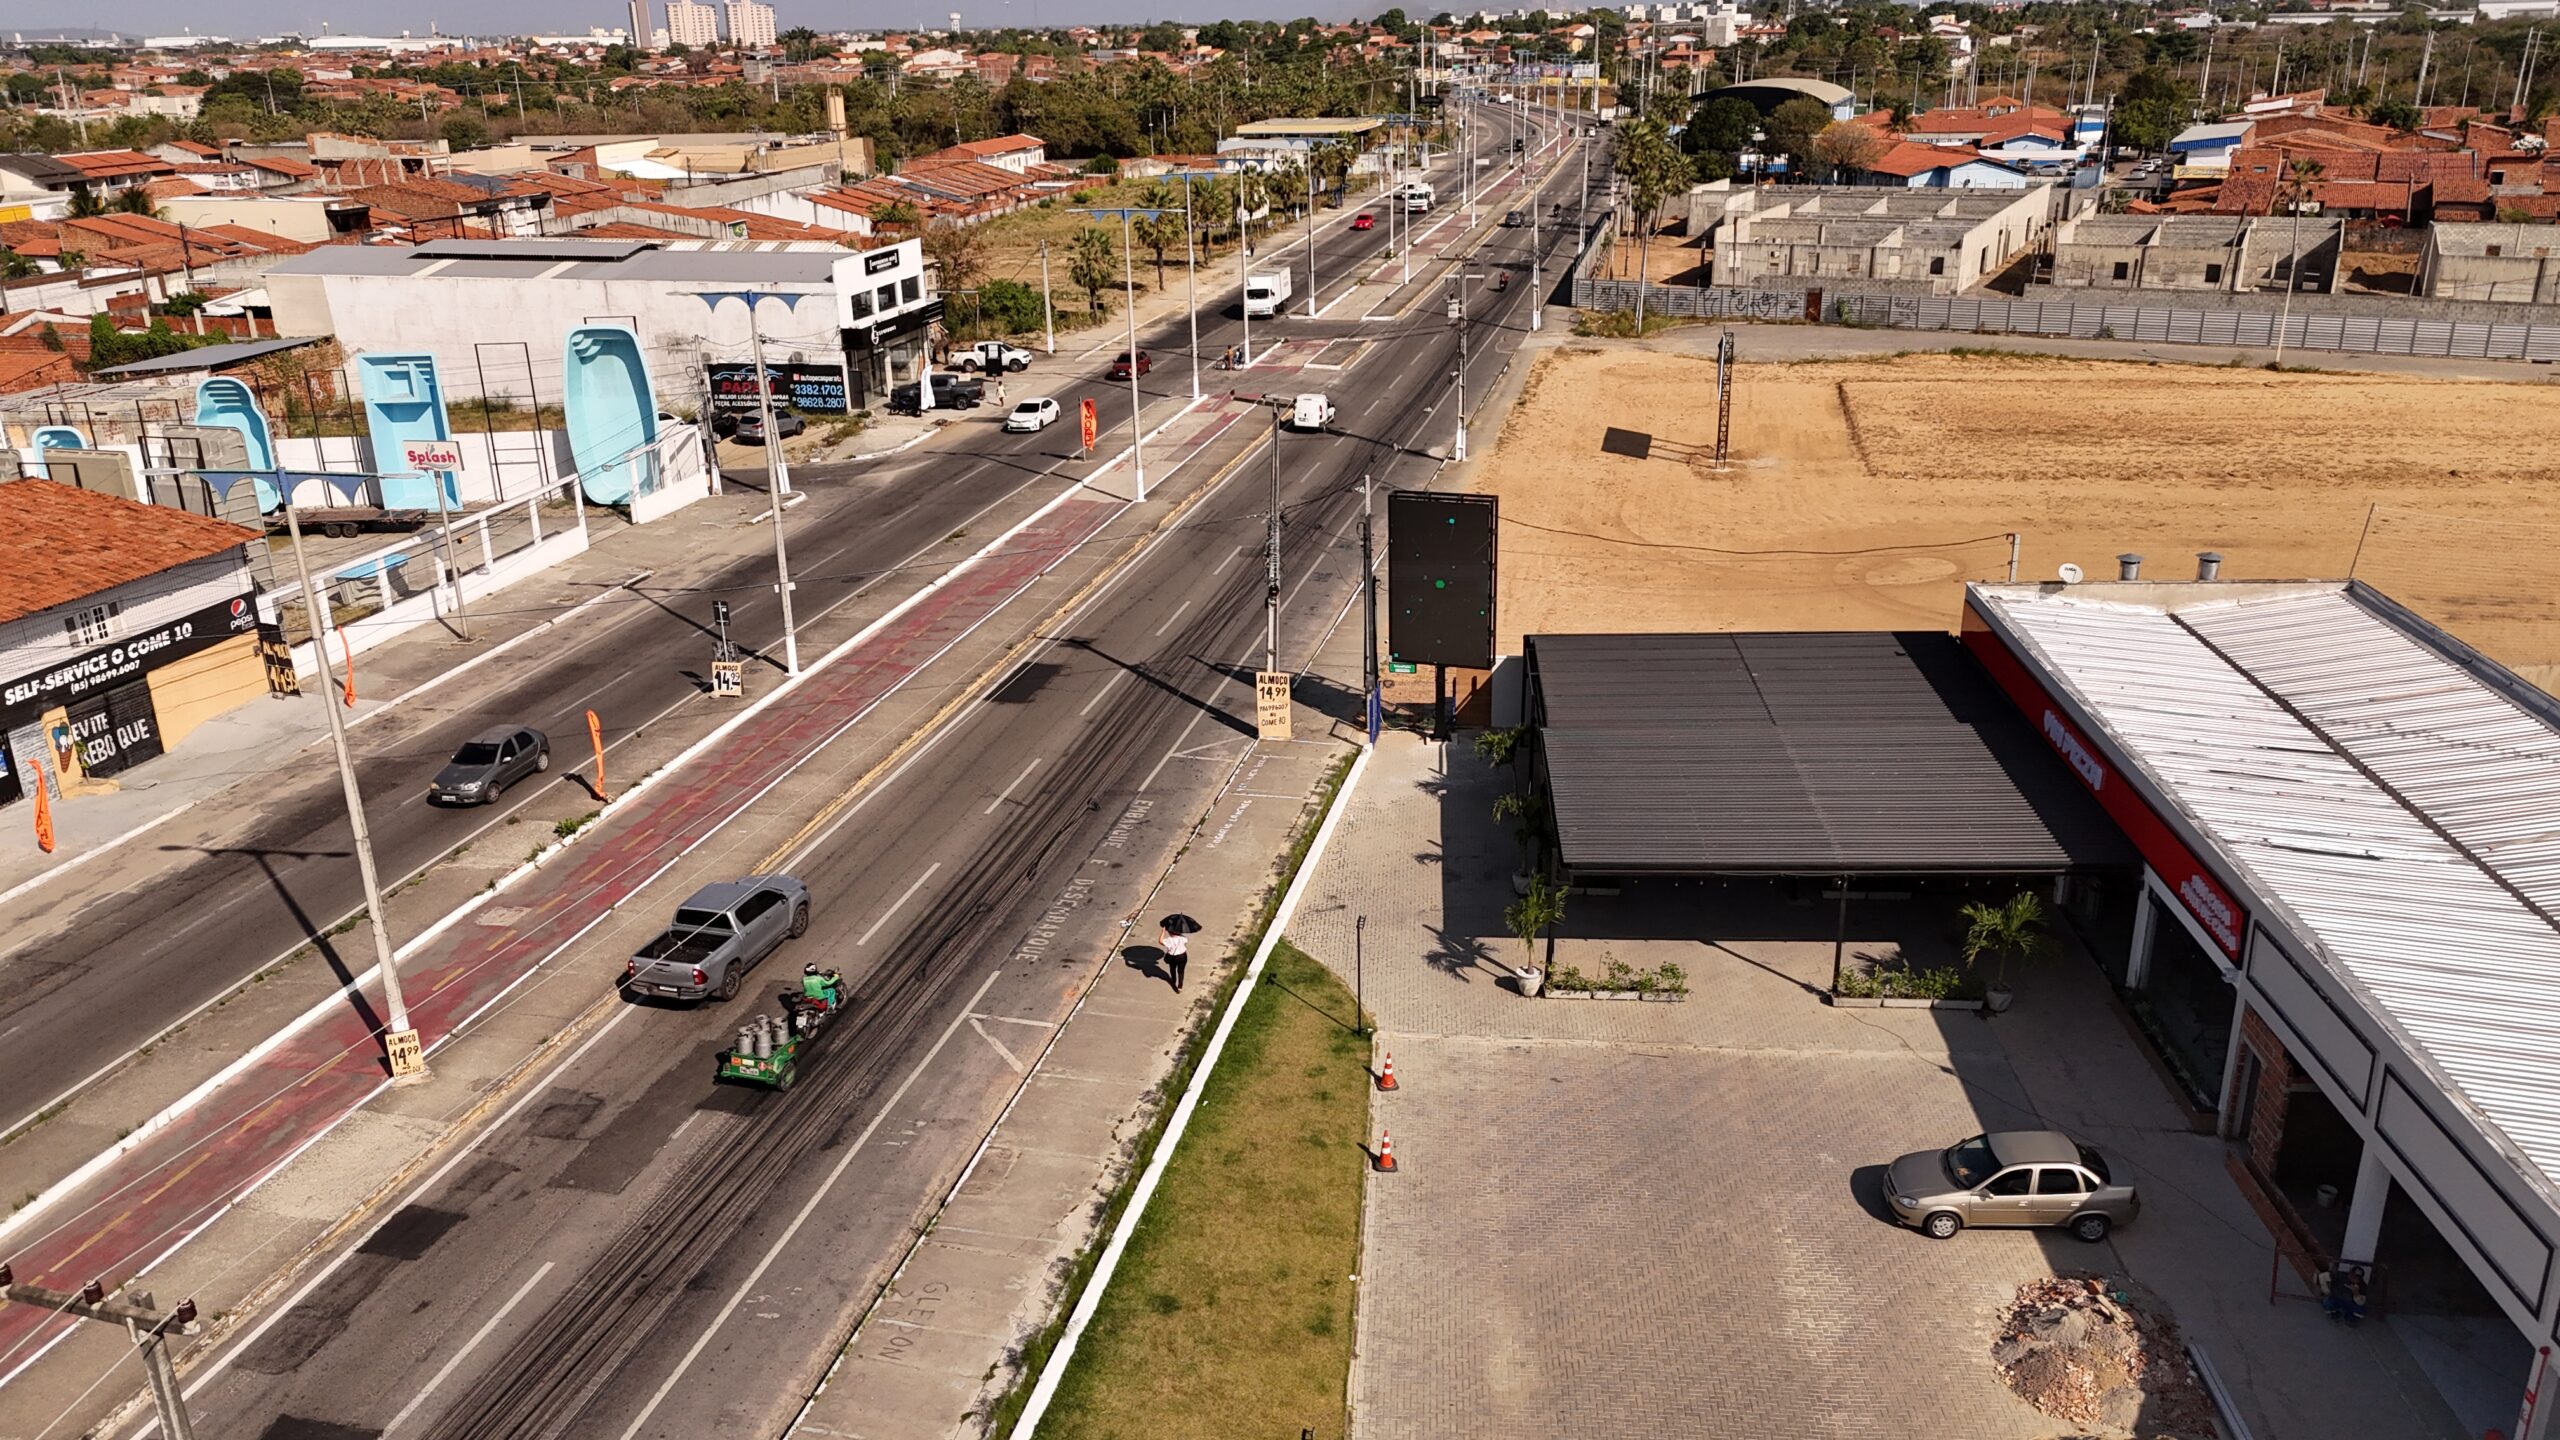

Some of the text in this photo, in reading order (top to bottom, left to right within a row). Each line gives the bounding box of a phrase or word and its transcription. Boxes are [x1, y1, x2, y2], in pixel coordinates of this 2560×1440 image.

[795, 384, 843, 395] 3382.1702
[797, 397, 846, 408] 98628.2807
[408, 450, 456, 465] Splash
[230, 613, 253, 630] pepsi
[4, 622, 192, 705] SELF-SERVICE O COME 10
[70, 660, 140, 694] (85) 98699.6007
[1259, 686, 1287, 701] 14,99
[71, 712, 109, 741] EVITE
[1103, 800, 1153, 848] EMBARQUE
[1015, 878, 1095, 961] DESEMBARQUE
